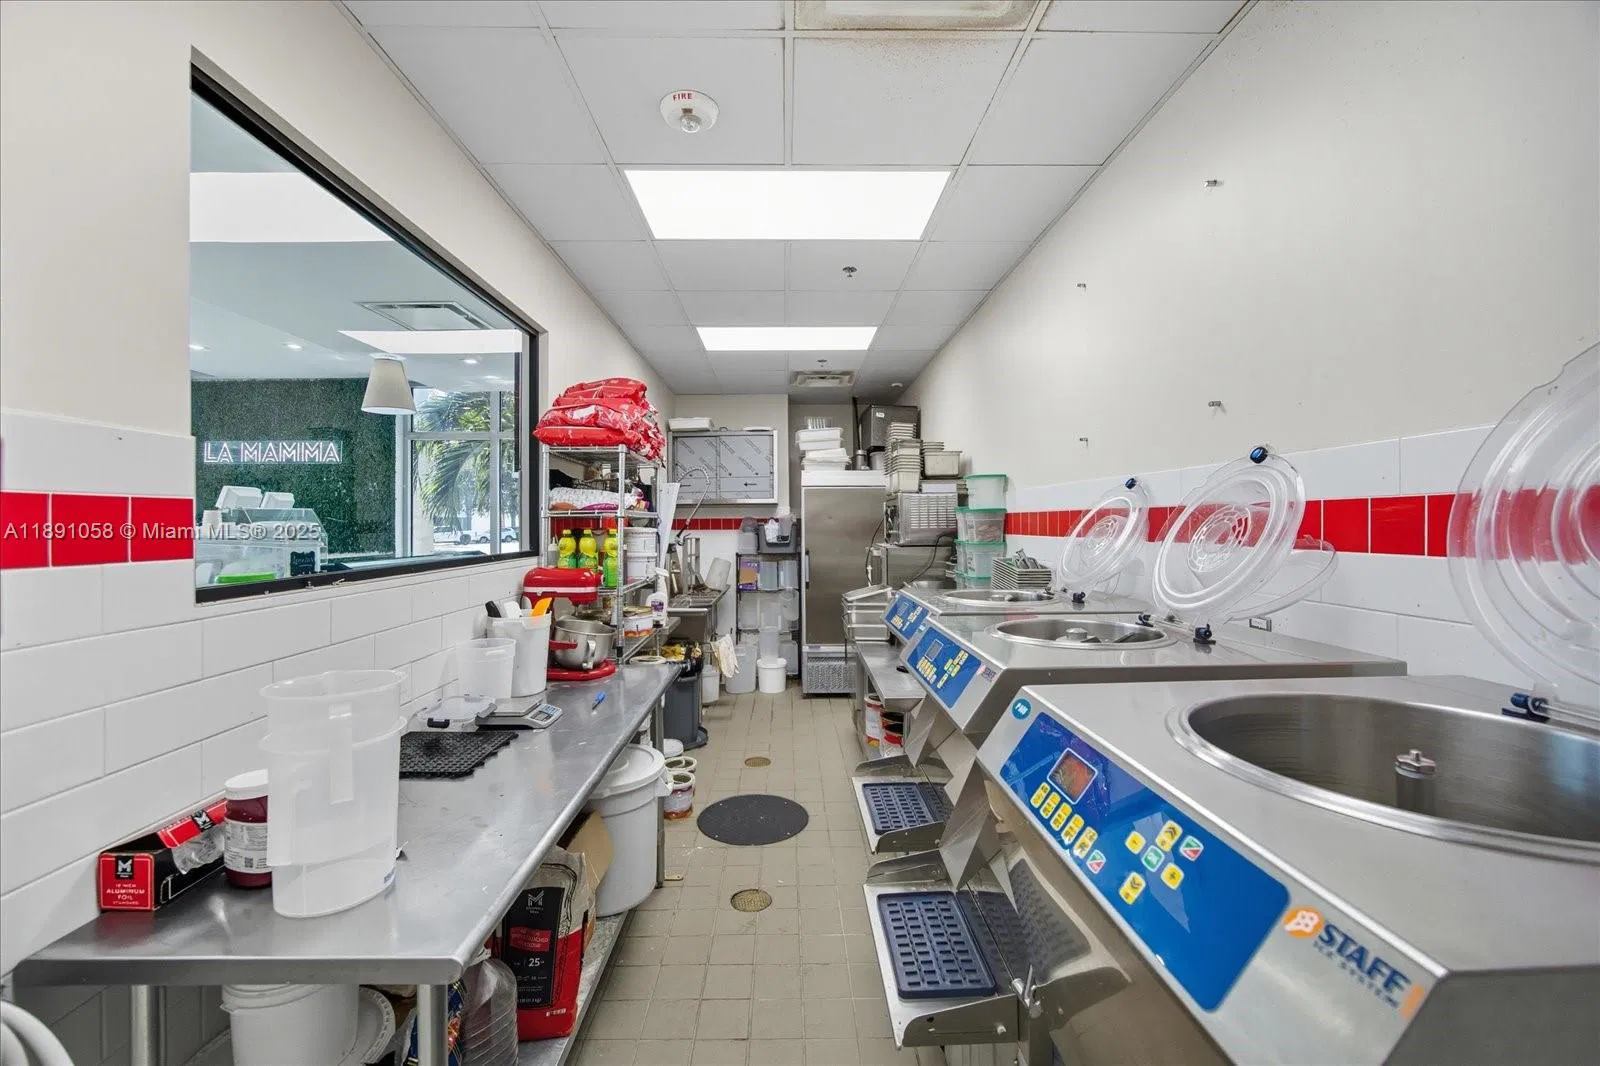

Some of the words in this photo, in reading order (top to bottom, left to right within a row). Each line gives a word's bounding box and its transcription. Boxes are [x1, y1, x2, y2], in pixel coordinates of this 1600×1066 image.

[672, 92, 693, 101] FIRE
[203, 441, 233, 463] LA
[240, 441, 340, 463] MAMMA
[528, 957, 541, 967] 25
[1318, 922, 1411, 992] STAFF
